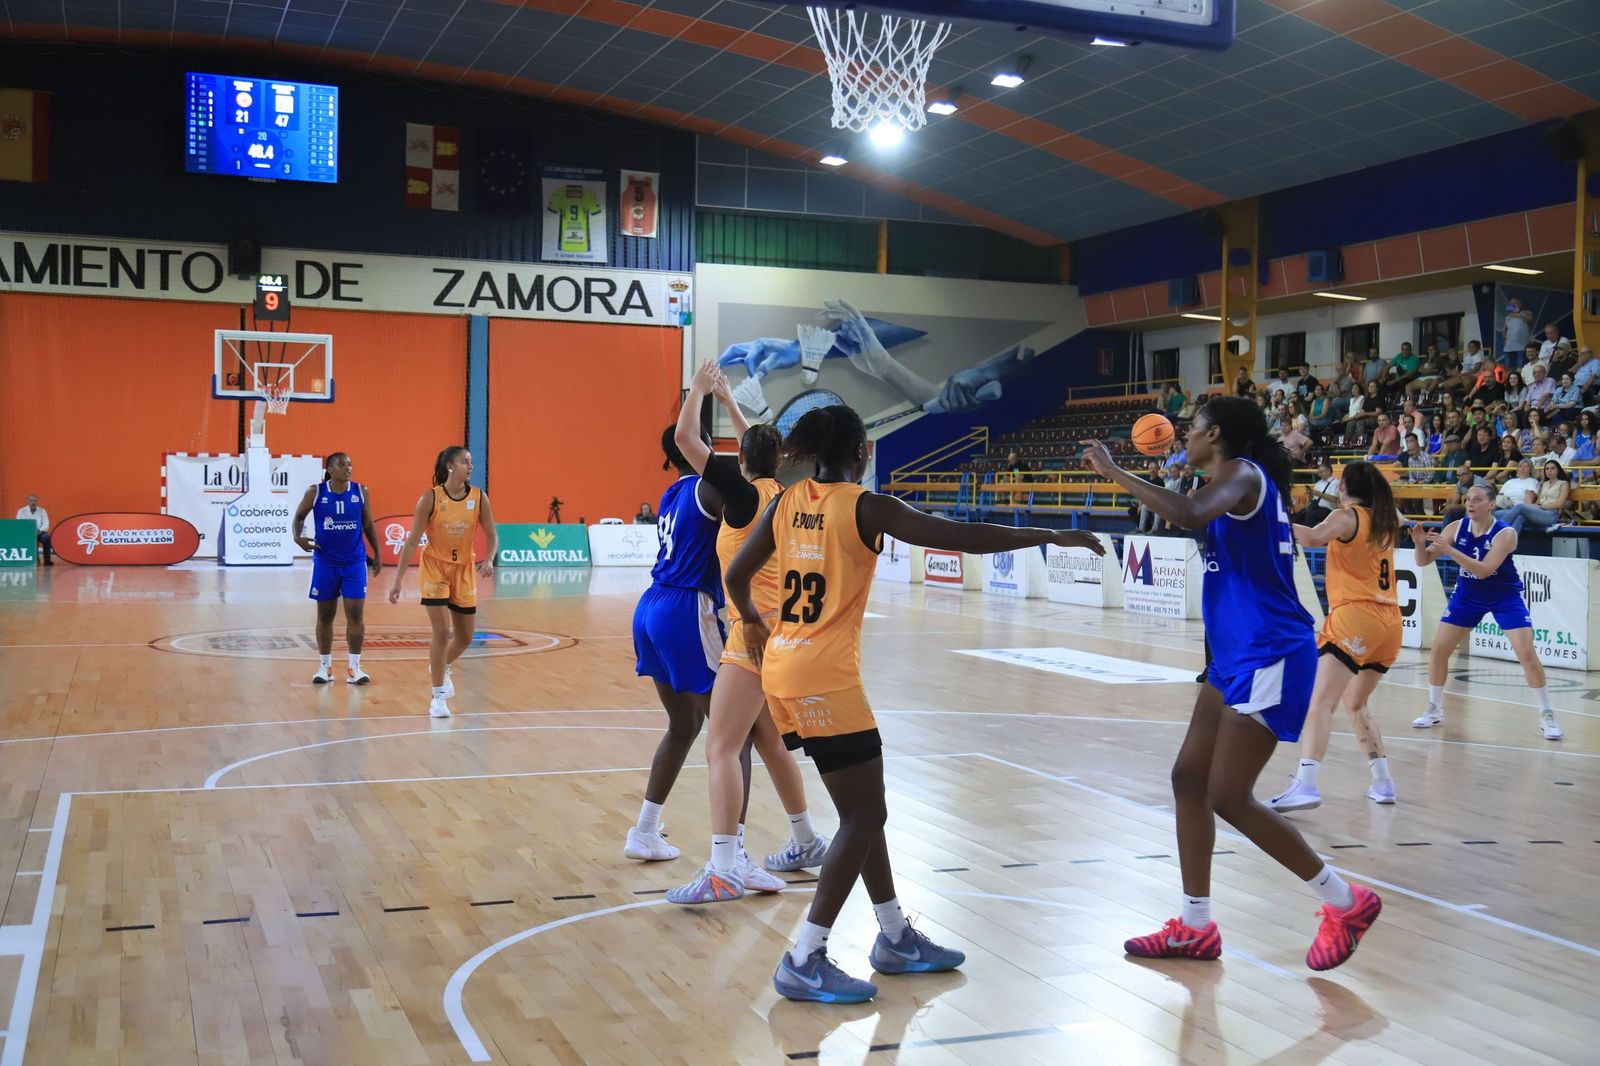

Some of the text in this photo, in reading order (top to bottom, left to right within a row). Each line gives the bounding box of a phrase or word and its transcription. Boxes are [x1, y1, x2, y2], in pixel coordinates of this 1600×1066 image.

[235, 109, 249, 123] 21
[275, 114, 289, 127] 47
[257, 131, 267, 141] 20
[235, 160, 241, 170] 1
[284, 164, 290, 174] 3
[571, 205, 578, 221] 9
[295, 259, 364, 303] DE
[432, 267, 654, 318] ZAMORA
[265, 292, 279, 311] 9
[203, 463, 289, 493] La Opón
[239, 508, 289, 517] cobreros
[335, 500, 345, 514] 11
[102, 529, 173, 537] BALONCESTO
[243, 525, 287, 534] cobreros
[247, 540, 282, 548] cobreros
[452, 549, 458, 561] 5
[500, 549, 588, 562] CAJA RURAL
[1472, 546, 1480, 561] 3
[949, 559, 958, 572] 22
[1378, 558, 1390, 591] 9
[781, 569, 826, 623] 23
[1556, 630, 1578, 646] S.L.
